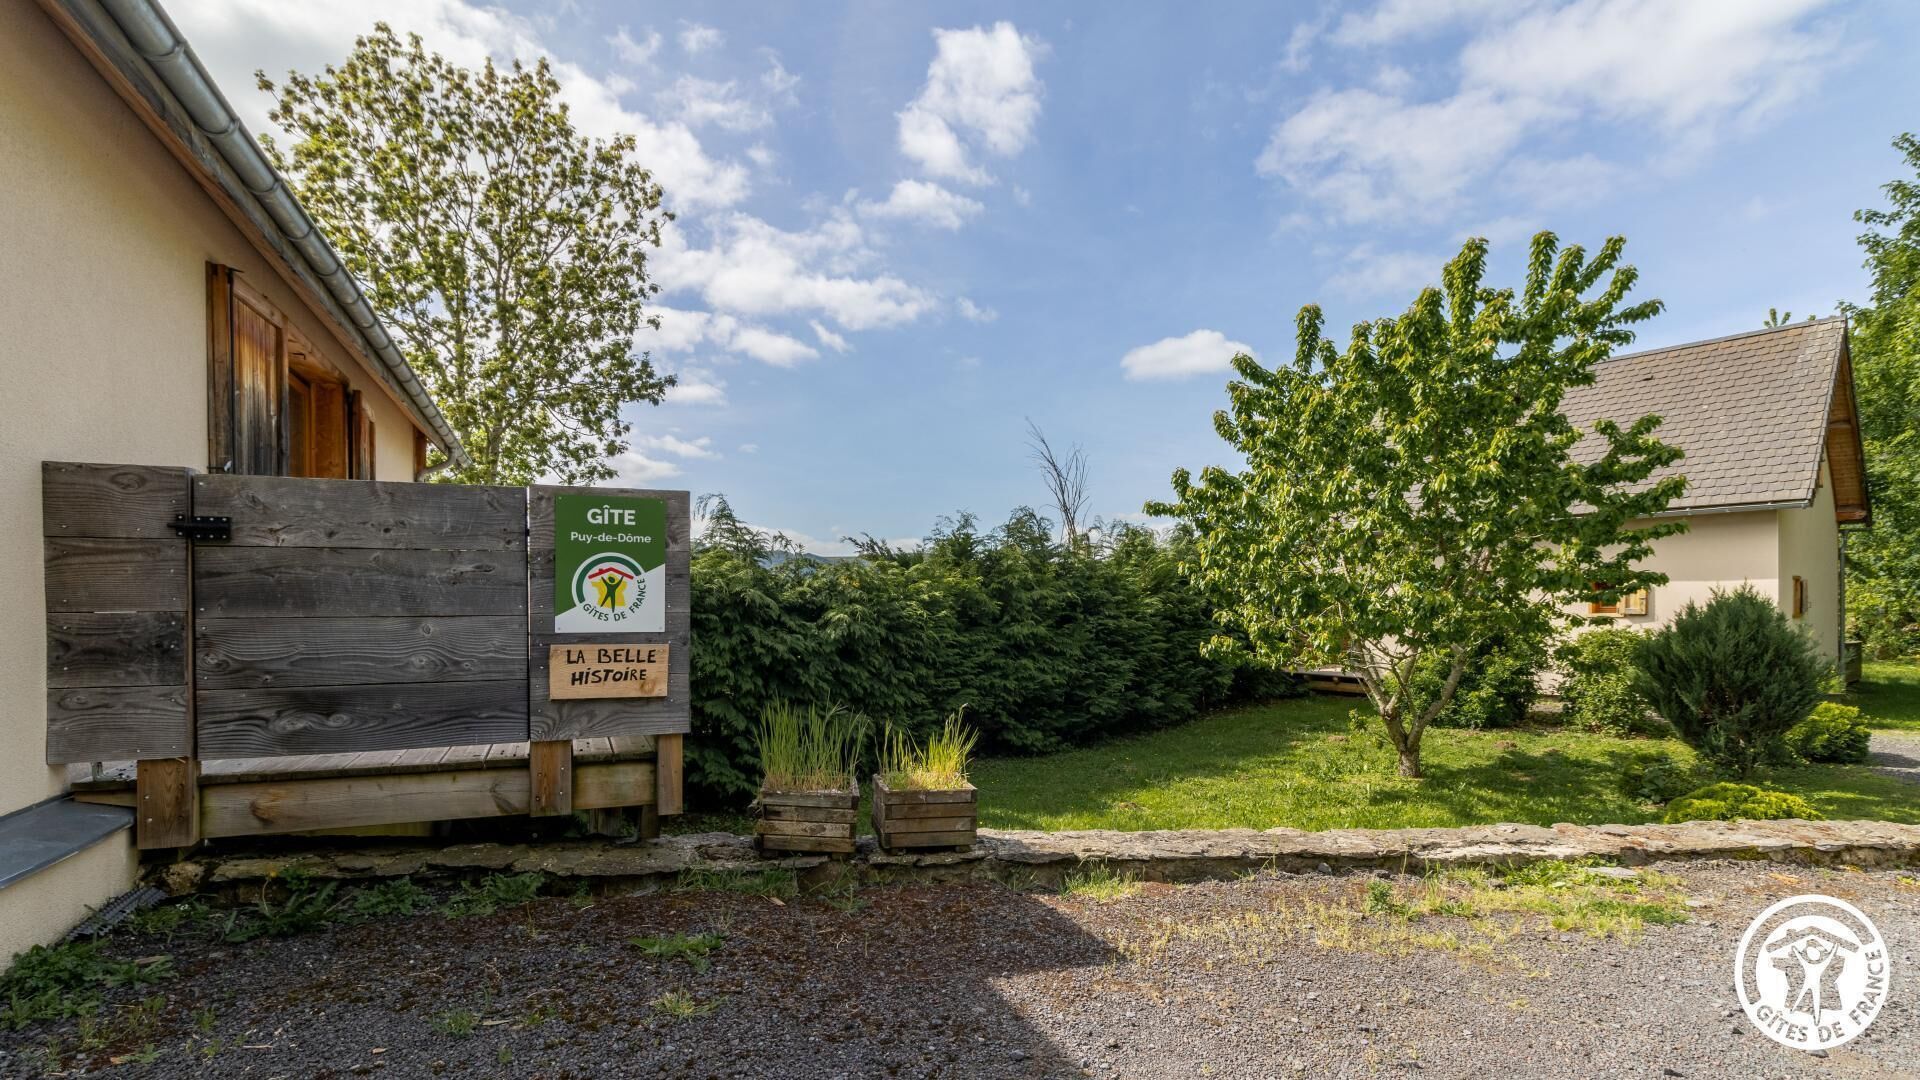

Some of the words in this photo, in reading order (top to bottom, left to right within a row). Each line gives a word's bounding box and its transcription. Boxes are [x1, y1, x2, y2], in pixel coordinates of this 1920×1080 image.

[587, 504, 636, 525] GÎTE
[570, 531, 652, 544] Puy-de-Dôme
[614, 611, 627, 622] DE
[630, 578, 647, 614] FRANCE
[566, 649, 585, 664] LA
[597, 648, 656, 664] BELLE
